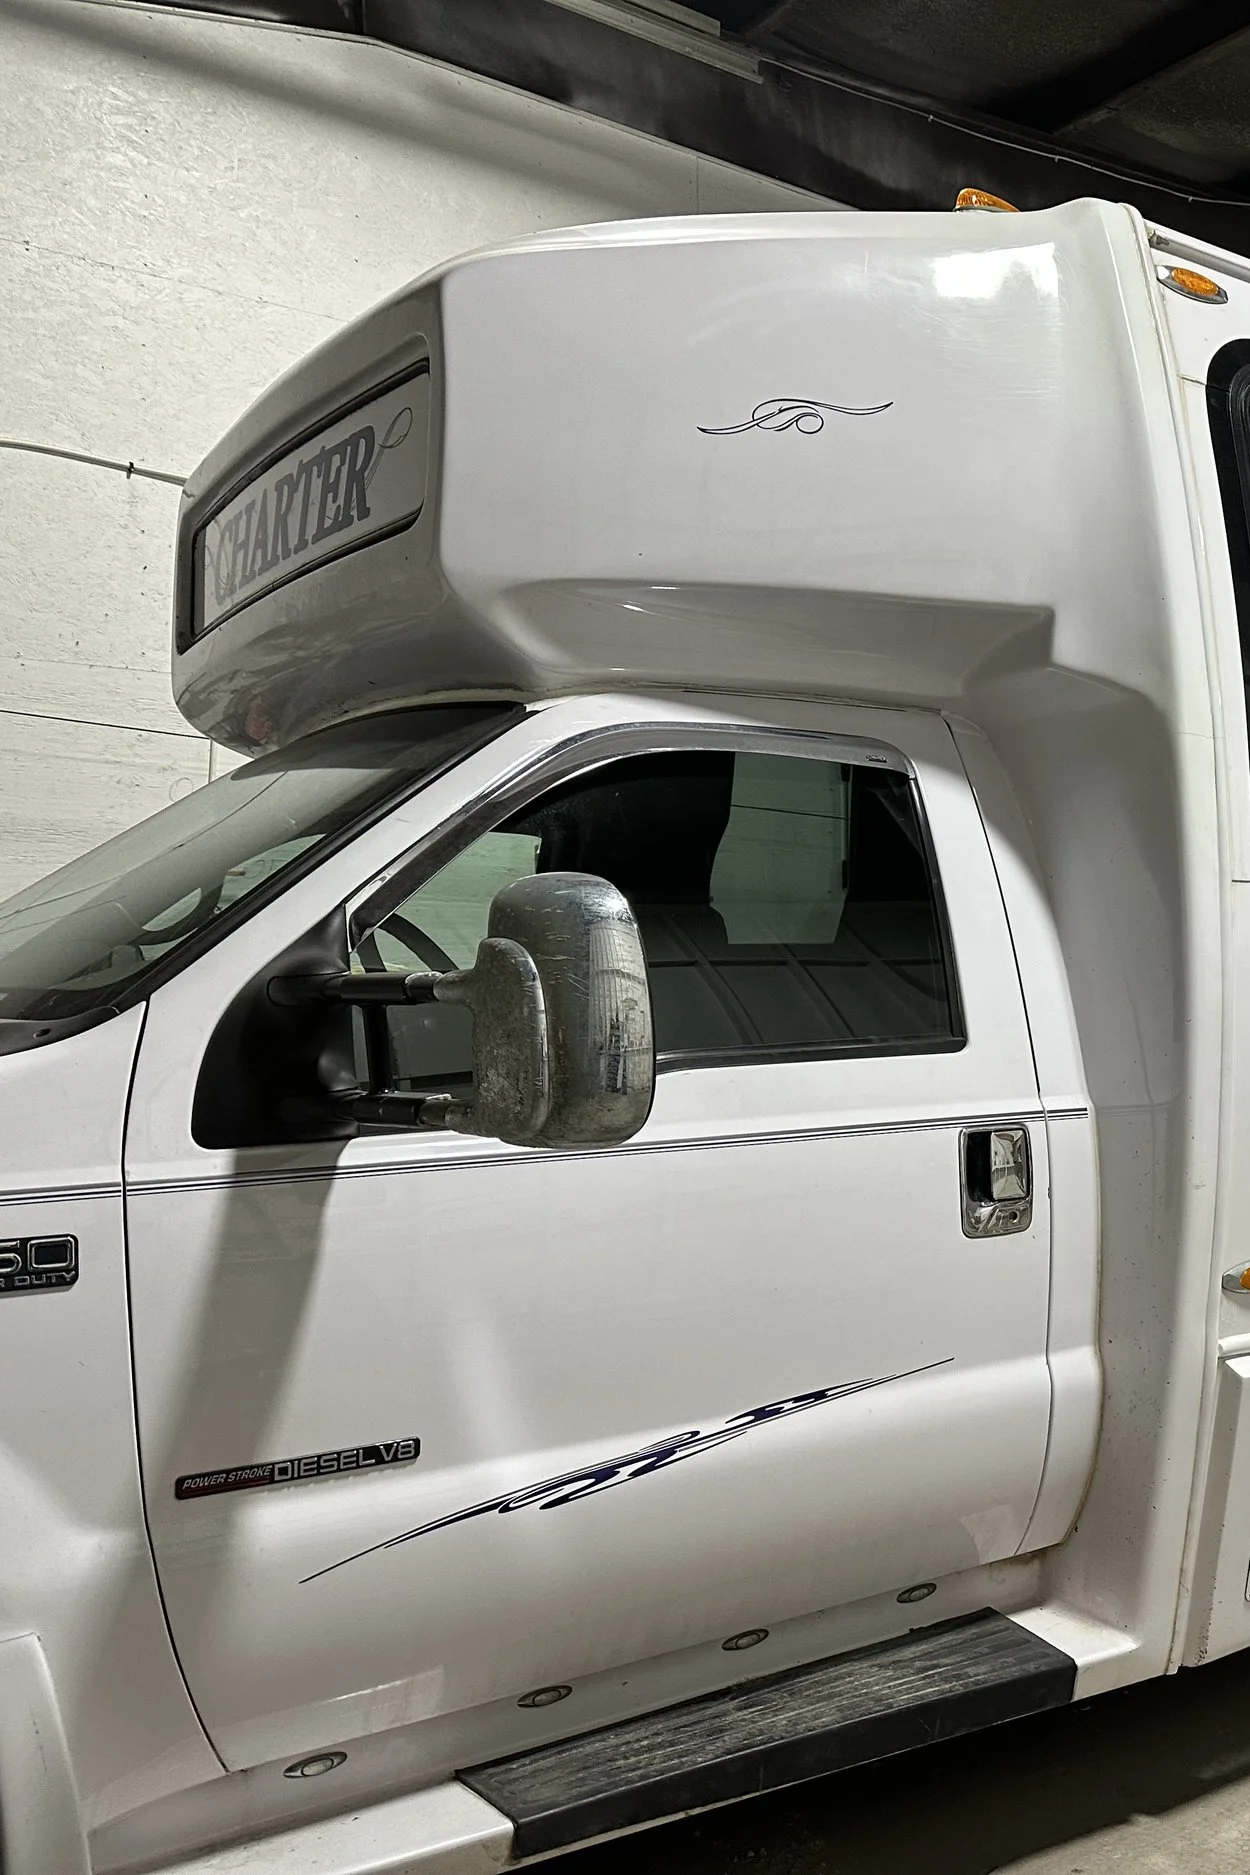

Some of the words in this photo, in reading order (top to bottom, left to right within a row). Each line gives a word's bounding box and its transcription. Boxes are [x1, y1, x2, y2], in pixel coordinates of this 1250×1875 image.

[213, 425, 376, 606] CHARTER
[14, 1270, 76, 1287] DUTY
[182, 1474, 226, 1490] POWER
[228, 1465, 273, 1482] STROKE
[274, 1449, 376, 1481] DIESEL
[379, 1439, 416, 1461] V8
